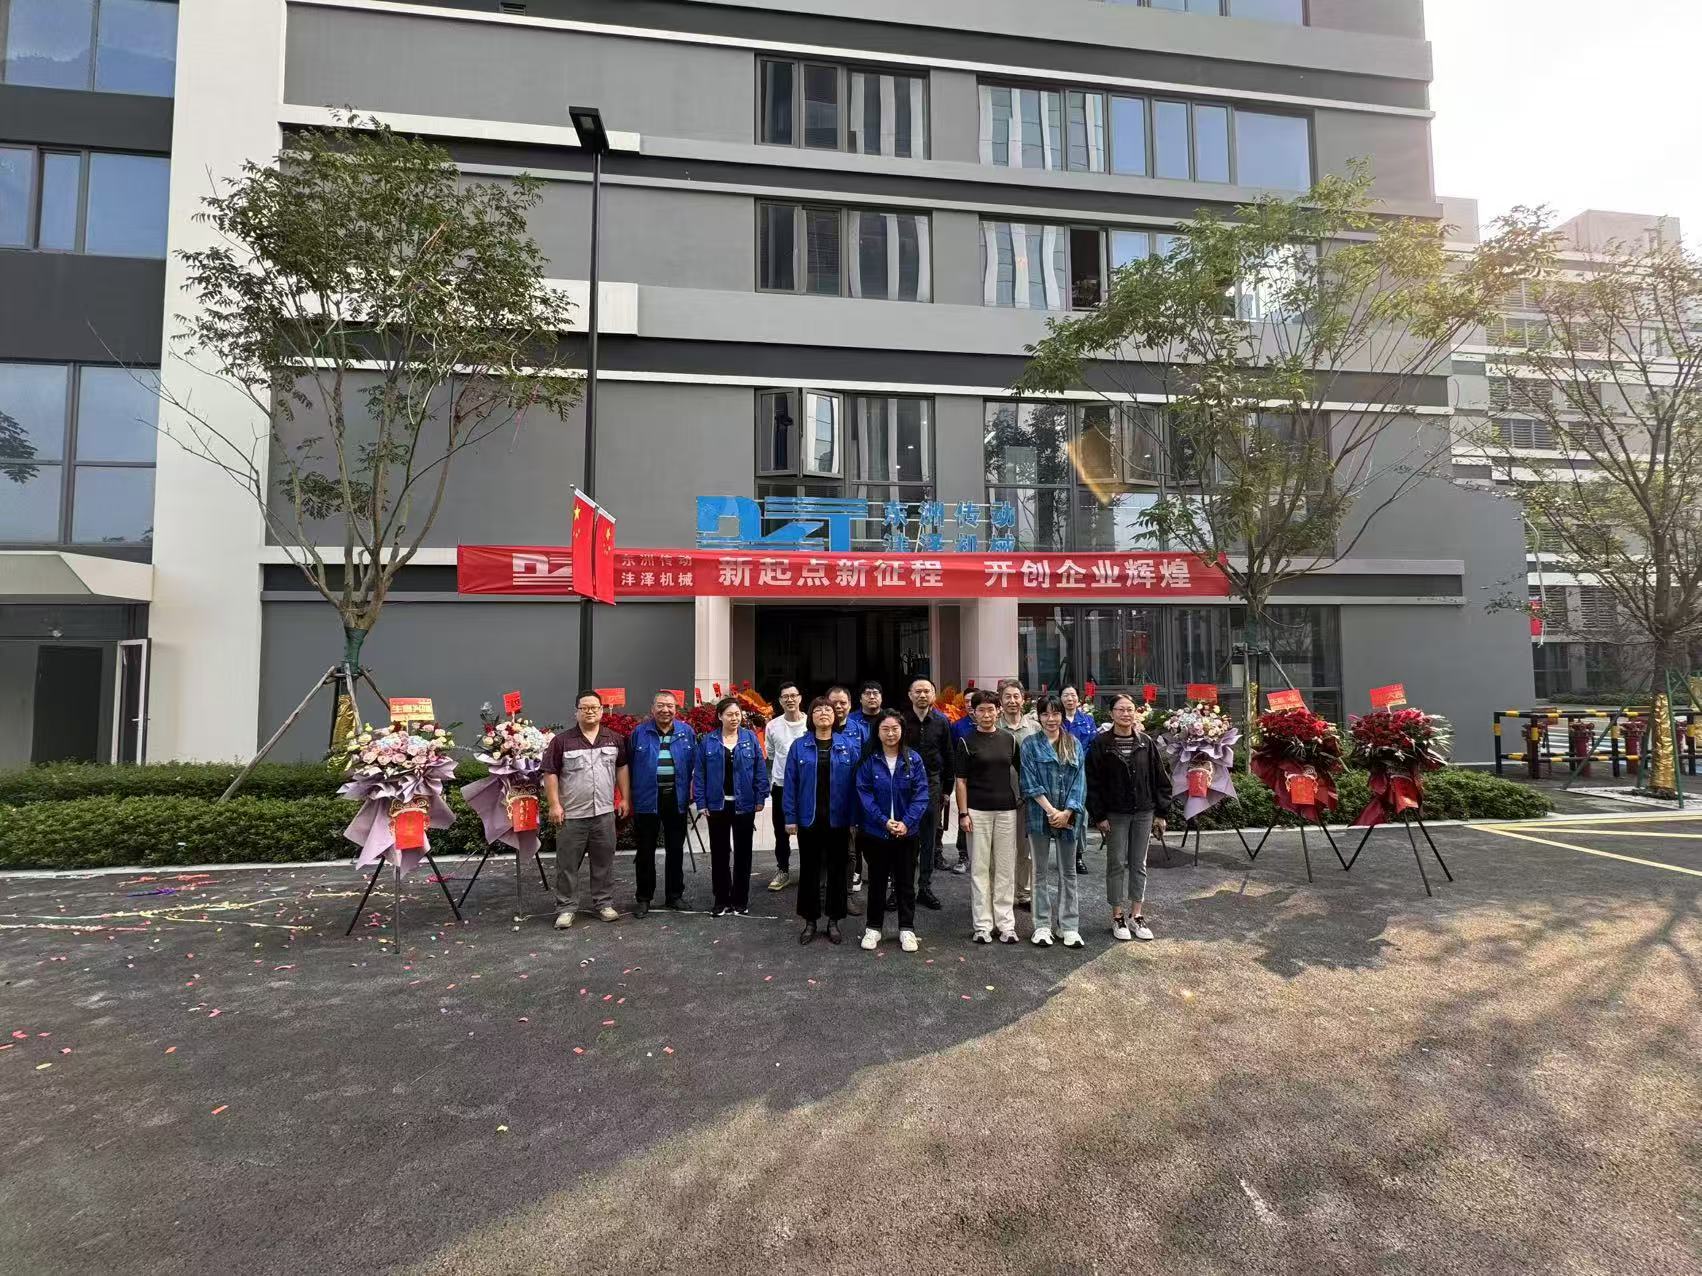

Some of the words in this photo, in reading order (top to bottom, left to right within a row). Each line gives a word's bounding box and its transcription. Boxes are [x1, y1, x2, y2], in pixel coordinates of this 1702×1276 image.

[882, 500, 1016, 528] 东洲传动
[621, 553, 692, 567] 东洲传动
[621, 571, 694, 587] 沣泽机械
[718, 557, 943, 588] 新起点新征程
[984, 559, 1191, 589] 开创企业辉煌
